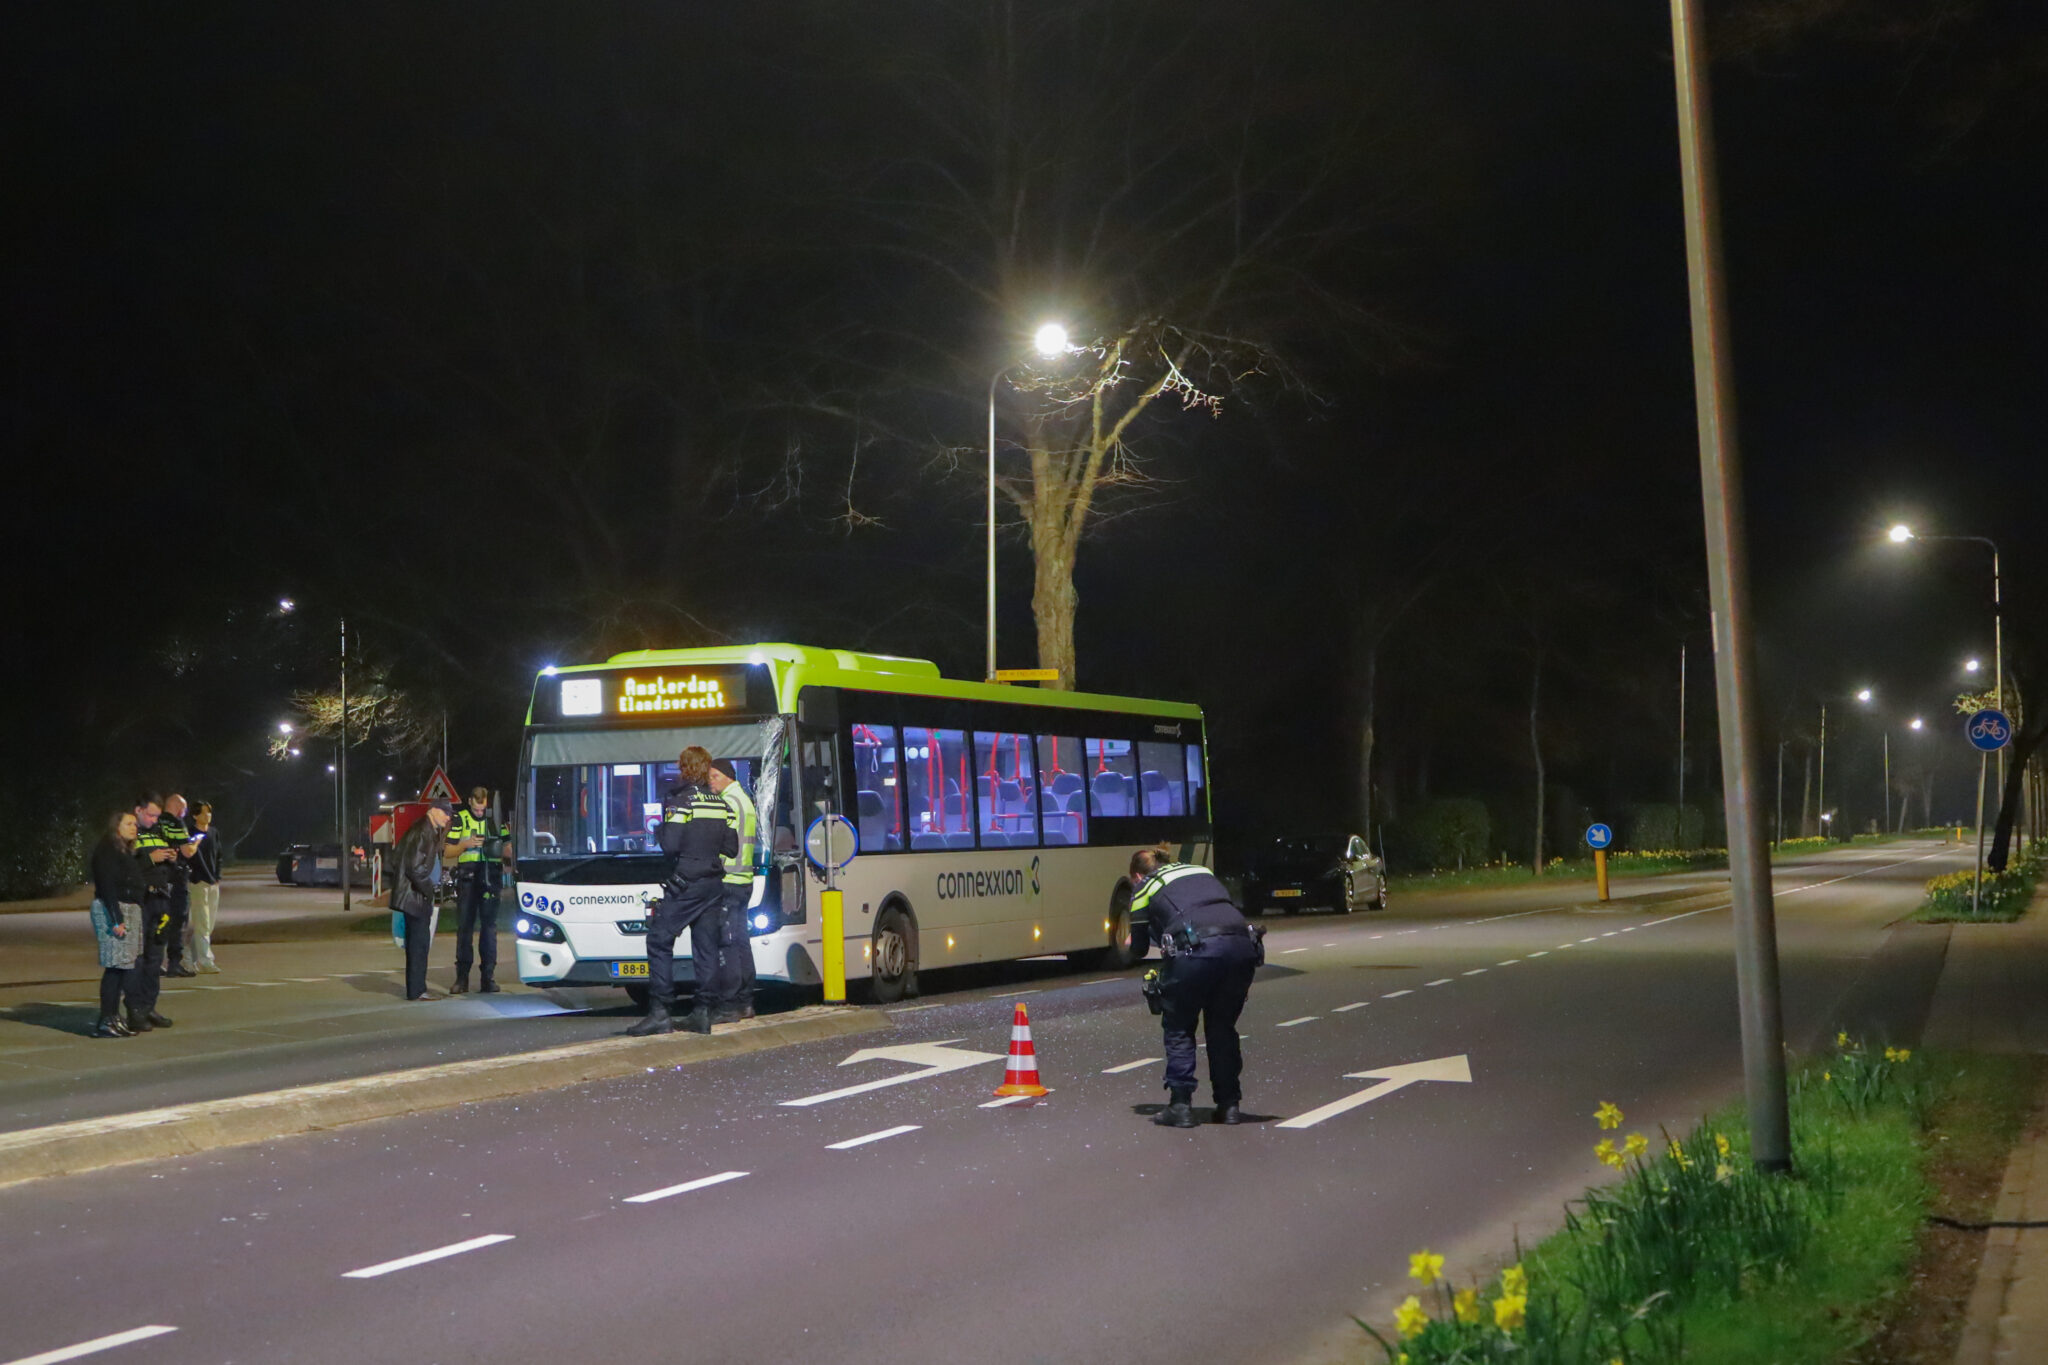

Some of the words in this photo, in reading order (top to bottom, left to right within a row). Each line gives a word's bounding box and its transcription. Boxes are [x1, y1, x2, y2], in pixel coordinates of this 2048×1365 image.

[624, 675, 719, 696] Amsterdam
[619, 691, 725, 712] Elandsgracht
[937, 869, 1023, 900] connexxion
[569, 895, 634, 905] connexxion
